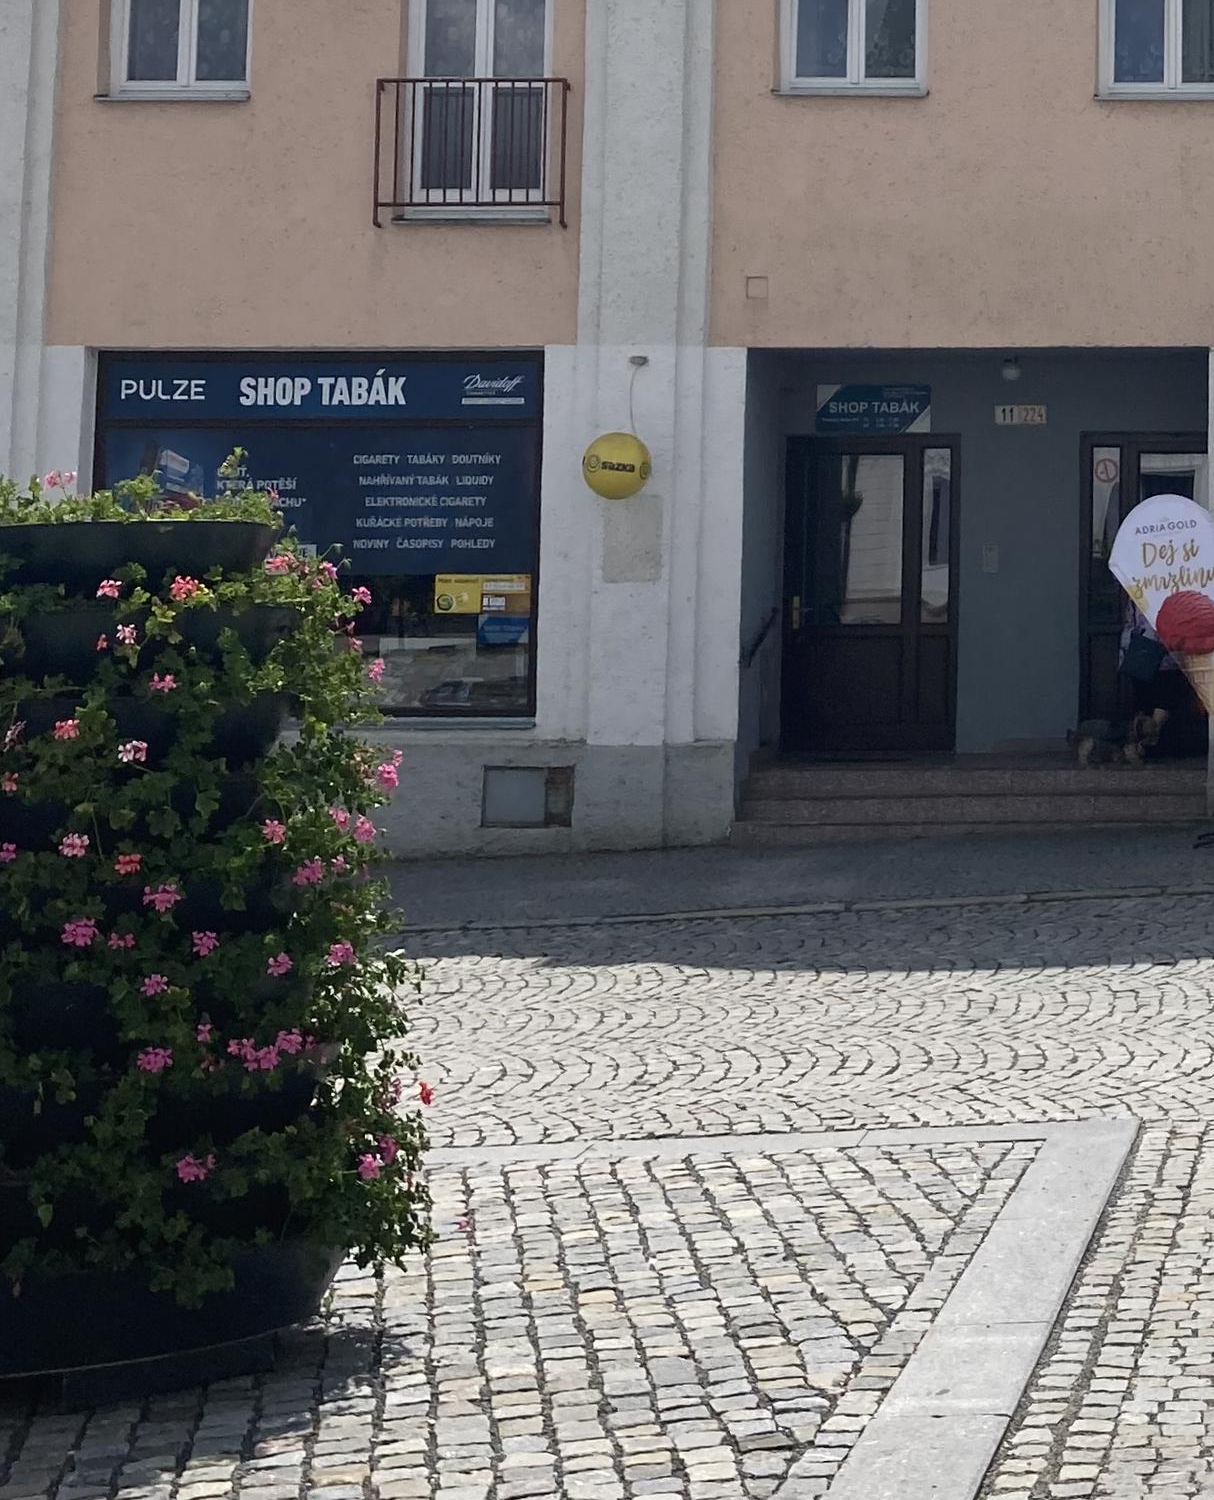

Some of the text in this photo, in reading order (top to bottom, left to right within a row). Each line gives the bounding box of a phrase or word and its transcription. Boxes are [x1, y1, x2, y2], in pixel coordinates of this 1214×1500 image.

[120, 379, 206, 400] PULZE
[239, 368, 407, 406] SHOP TABÁK
[462, 373, 526, 393] Davidoff
[828, 401, 869, 414] SHOP
[1001, 407, 1015, 422] 11
[353, 452, 501, 465] CIGARETY TABÁKY DOUTNÍKY
[416, 474, 449, 486] TABÁK
[456, 475, 494, 486] LIQUIDY
[365, 495, 487, 507] ELEKTRONICKÉ CIGARETY
[404, 515, 448, 528] POTŘEBY
[455, 515, 494, 528] NÁPOJE
[352, 537, 496, 549] NOVINY ČASOPISY POHLEDY
[1142, 538, 1200, 568] Dej si
